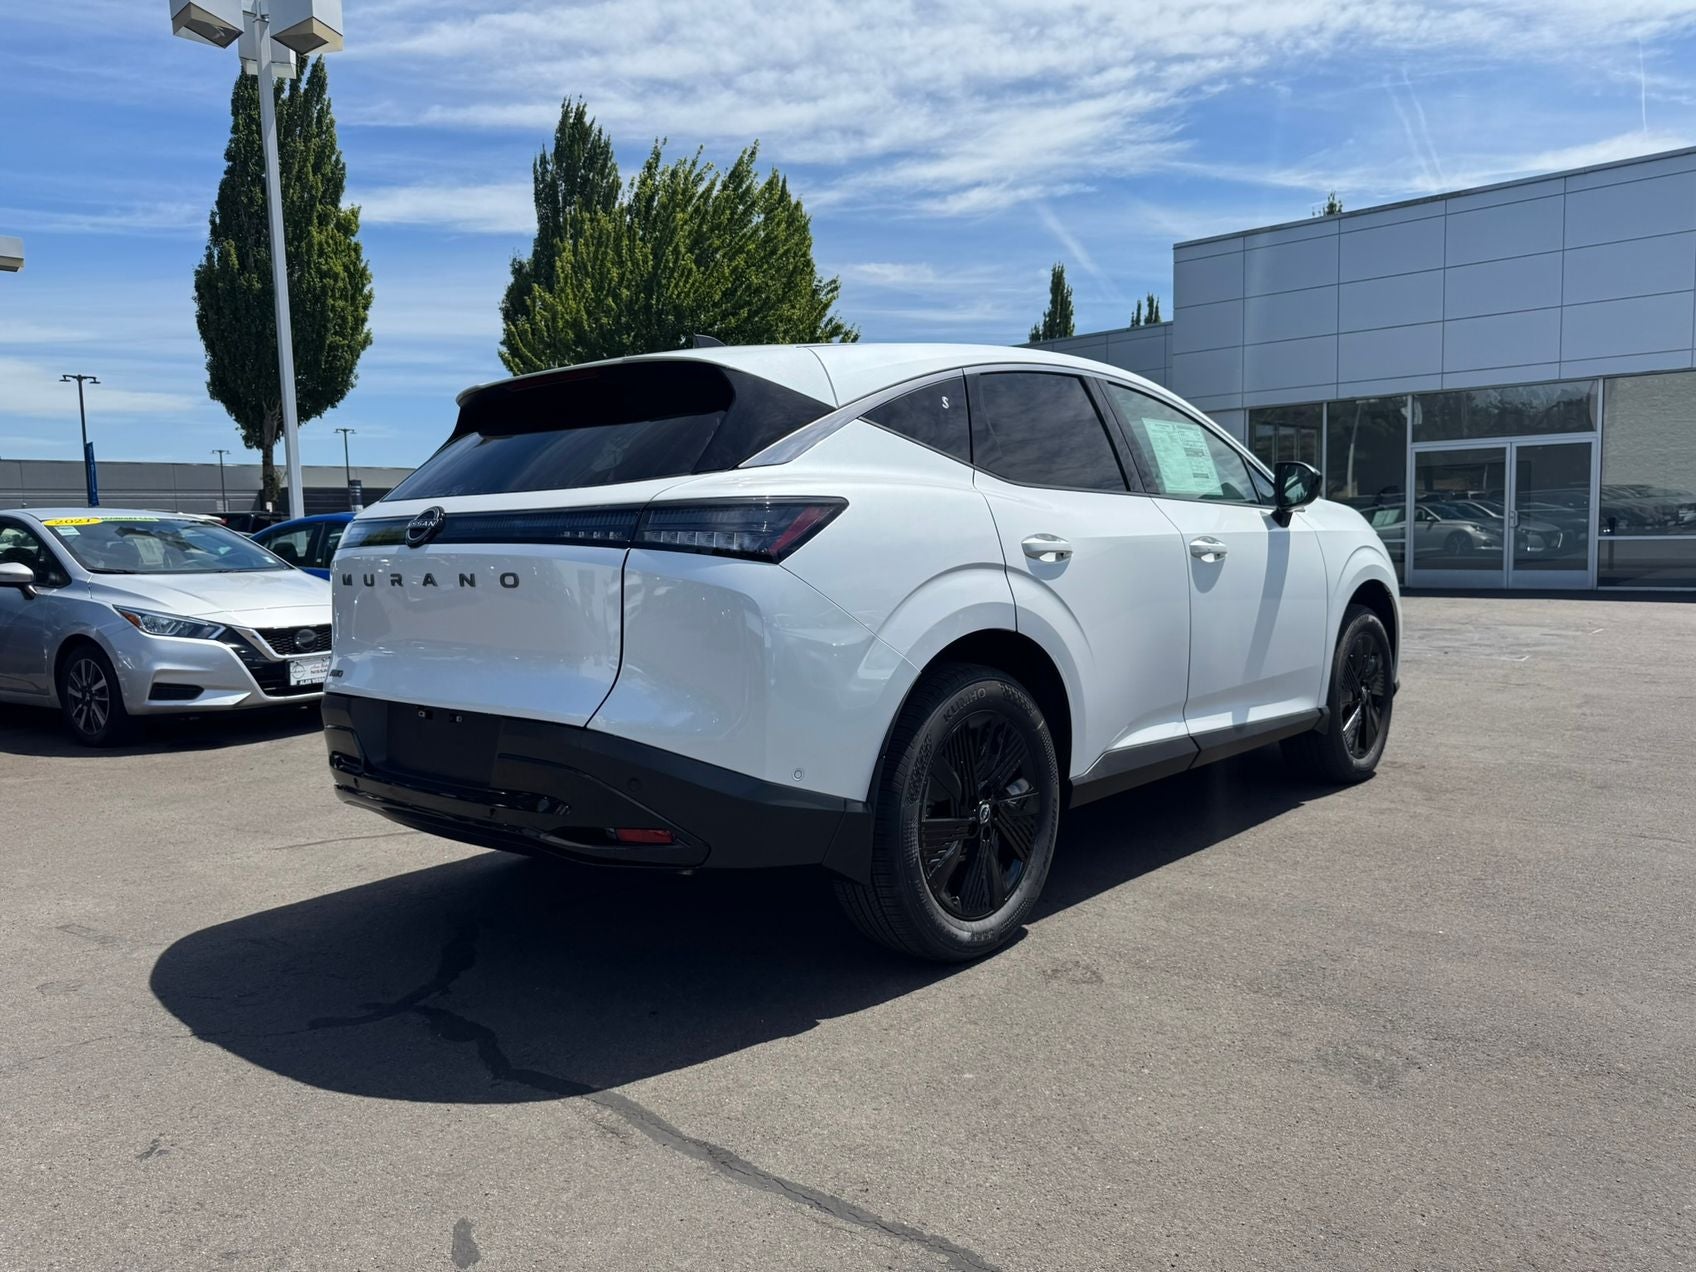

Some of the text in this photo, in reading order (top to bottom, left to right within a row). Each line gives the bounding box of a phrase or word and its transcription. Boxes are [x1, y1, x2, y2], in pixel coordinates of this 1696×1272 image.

[941, 396, 950, 409] S
[342, 572, 520, 589] MURANO
[943, 688, 986, 722] KUMHO
